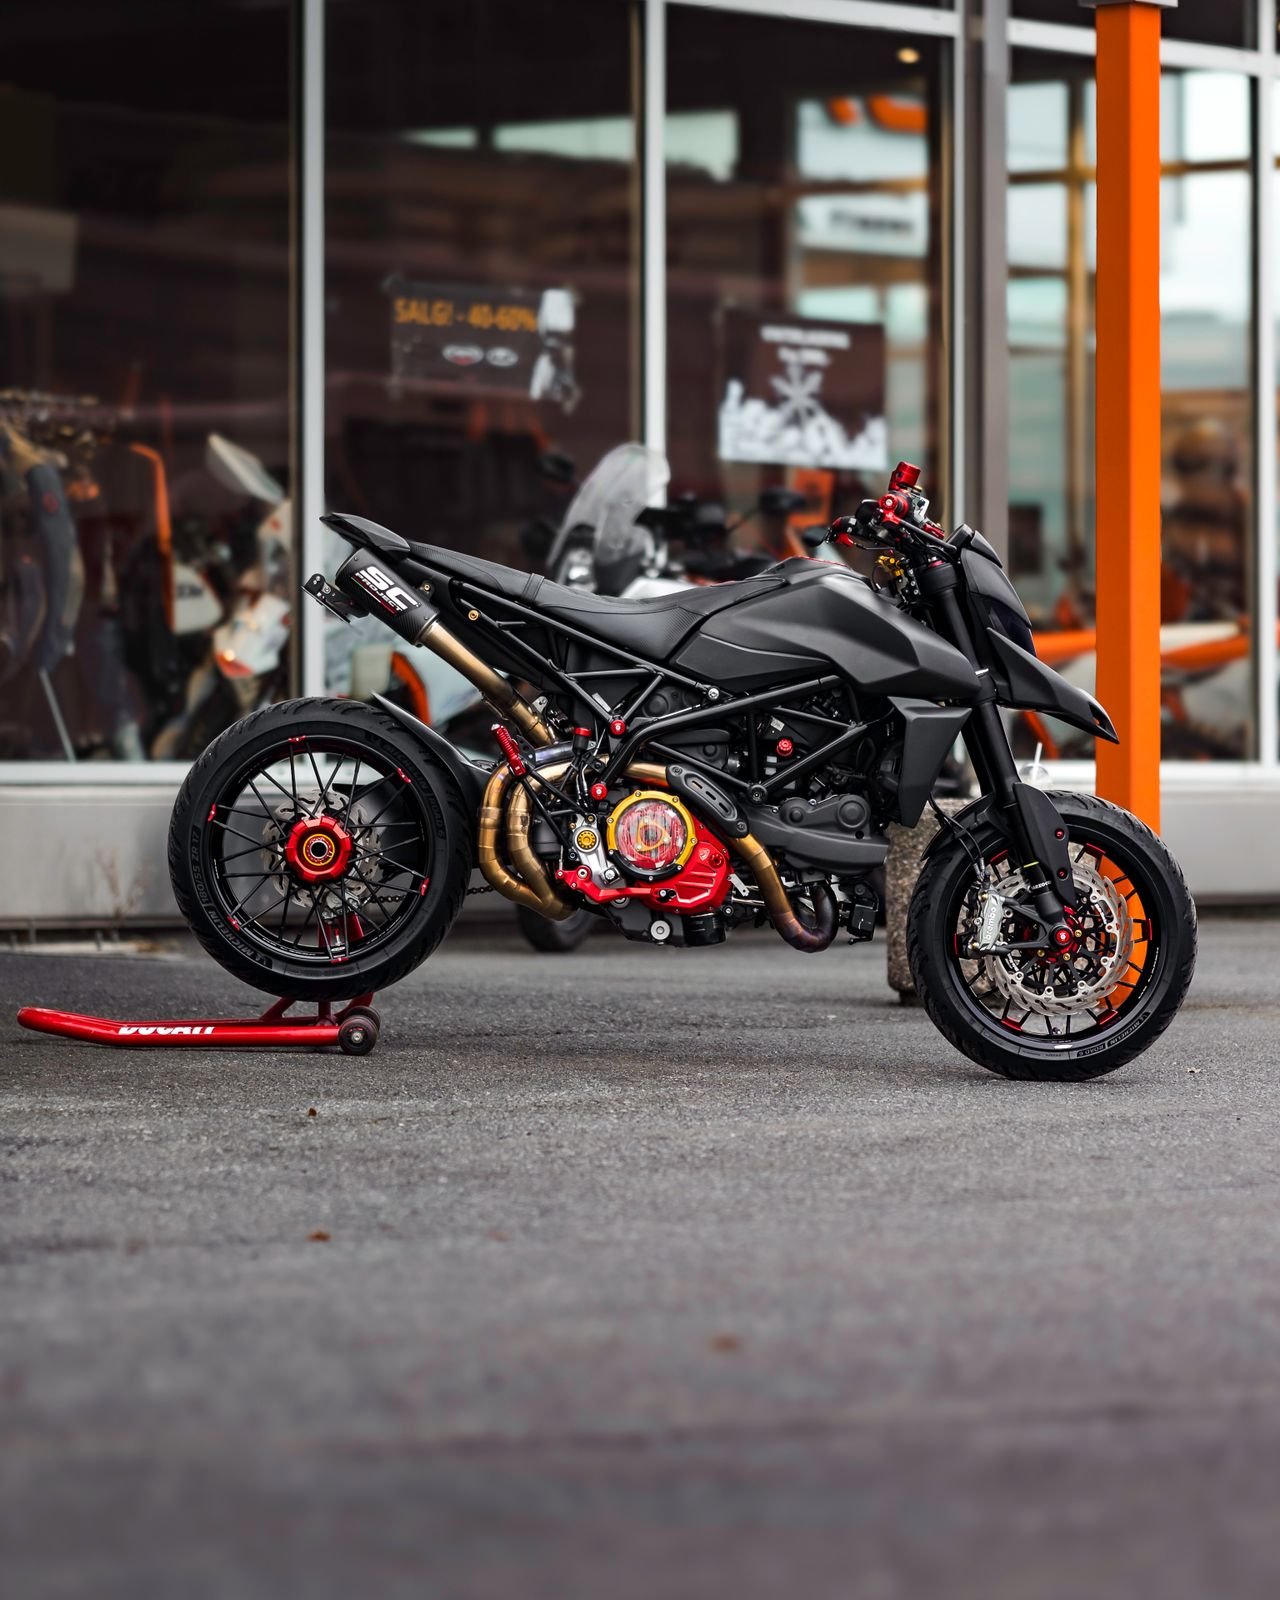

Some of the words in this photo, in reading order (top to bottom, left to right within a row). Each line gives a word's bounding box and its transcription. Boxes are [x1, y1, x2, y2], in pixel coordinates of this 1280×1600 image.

[355, 572, 402, 611] PROJECT
[208, 910, 254, 957] MICHELIN
[985, 907, 996, 940] brembo
[1110, 1021, 1141, 1044] MICHELIN
